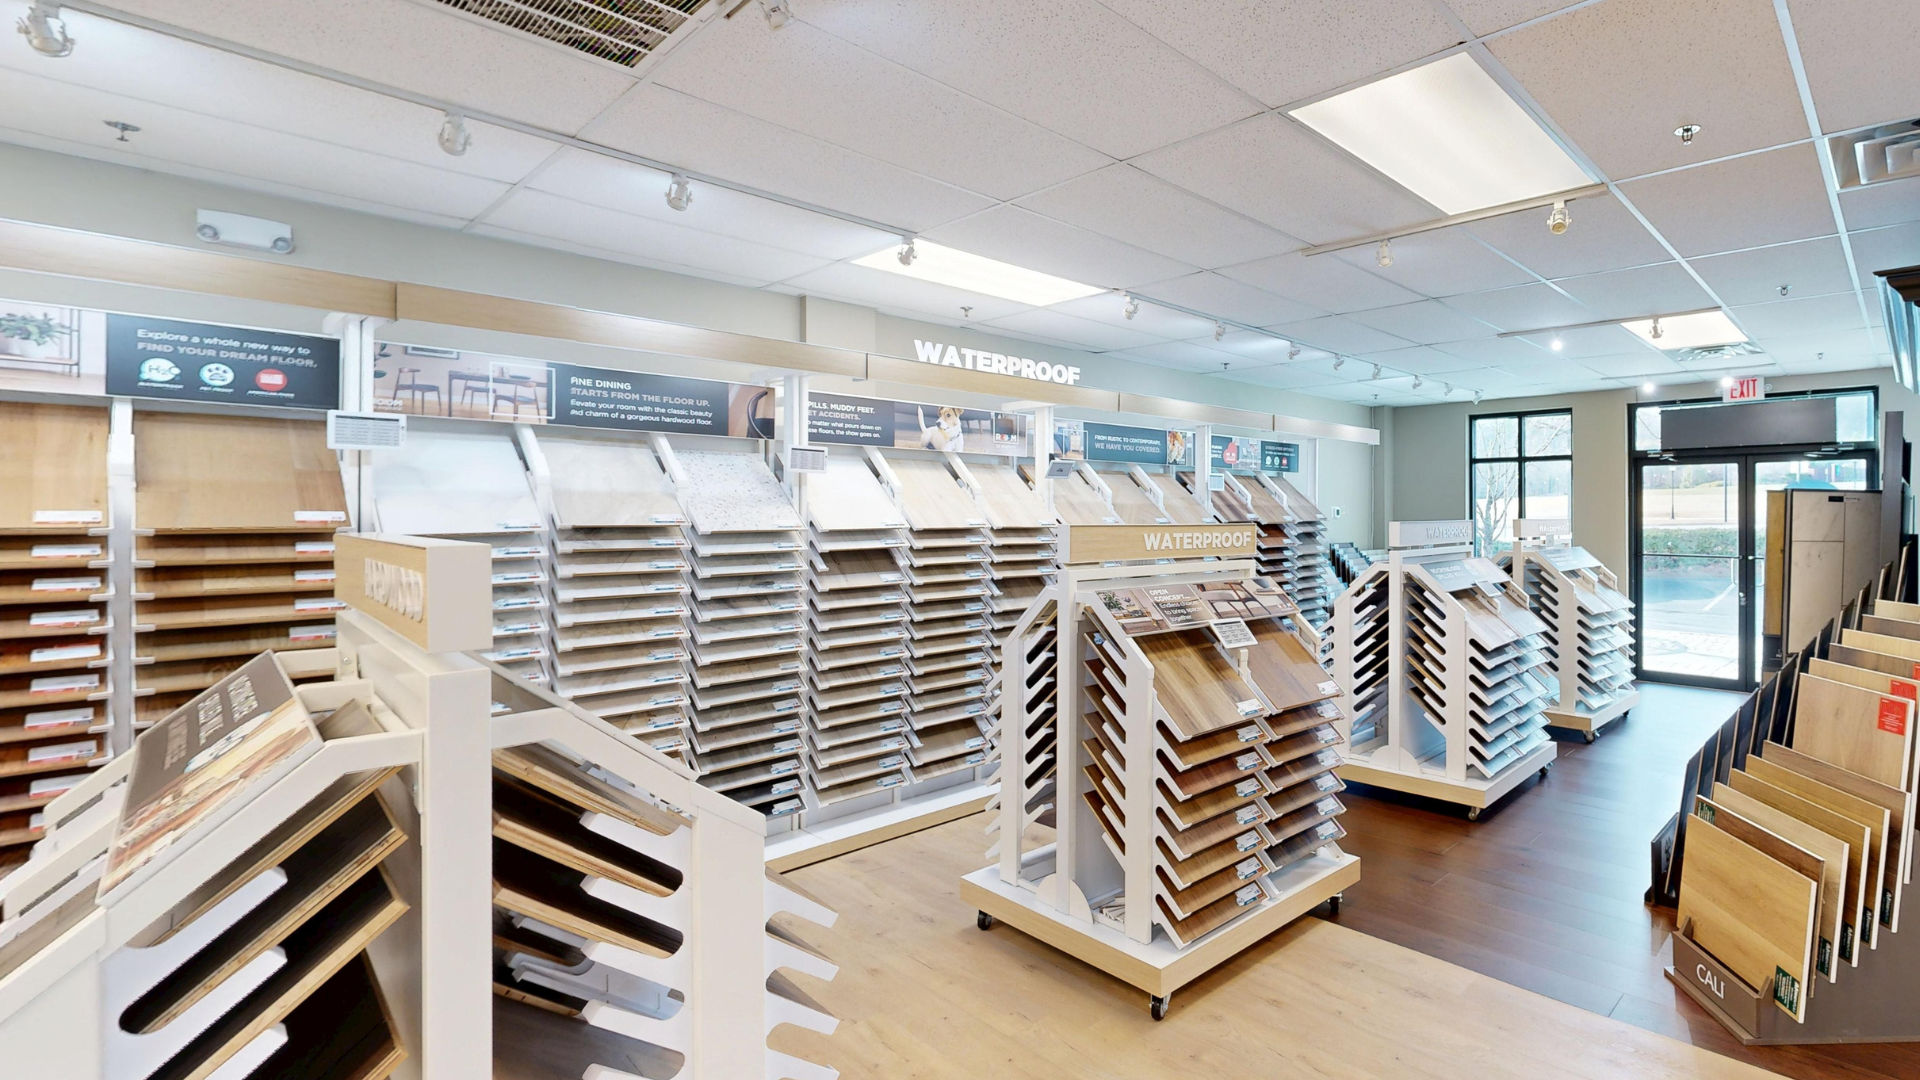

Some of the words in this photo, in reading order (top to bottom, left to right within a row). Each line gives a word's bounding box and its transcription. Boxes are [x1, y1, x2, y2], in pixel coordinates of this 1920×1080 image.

[137, 328, 189, 342] Explore
[190, 335, 200, 343] a
[202, 336, 241, 348] whole
[243, 341, 269, 350] new
[271, 344, 296, 355] way
[297, 346, 311, 355] to
[137, 341, 174, 353] FIND
[177, 346, 217, 357] YOUR
[219, 350, 268, 362] DREAM
[913, 339, 1081, 385] WATERPROOF
[595, 379, 631, 390] DINING
[1730, 378, 1758, 399] EXIT
[571, 386, 609, 398] STARTS
[611, 391, 639, 401] FROM
[641, 394, 661, 403] THE
[663, 396, 695, 406] FLOOR
[696, 399, 710, 407] UP.
[654, 406, 666, 414] the
[667, 407, 689, 416] classic
[690, 409, 713, 418] beauty
[808, 400, 829, 410] PILLS.
[830, 403, 856, 412] MUDDY
[857, 405, 876, 414] FEET.
[808, 409, 818, 417] ET
[818, 411, 861, 421] ACCIDENTS.
[585, 410, 609, 418] charm
[610, 411, 619, 419] of
[626, 414, 660, 422] gorgeous
[661, 415, 696, 424] hardwood
[696, 418, 713, 426] floor.
[1107, 435, 1122, 443] RUSTIC
[1094, 442, 1105, 450] WE
[1105, 443, 1122, 451] HAVE
[1122, 444, 1135, 452] YOU
[1135, 445, 1162, 454] COVERED.
[1143, 531, 1252, 551] WATERPROOF
[1149, 588, 1169, 596] OPEN
[1696, 963, 1726, 999] CALI
